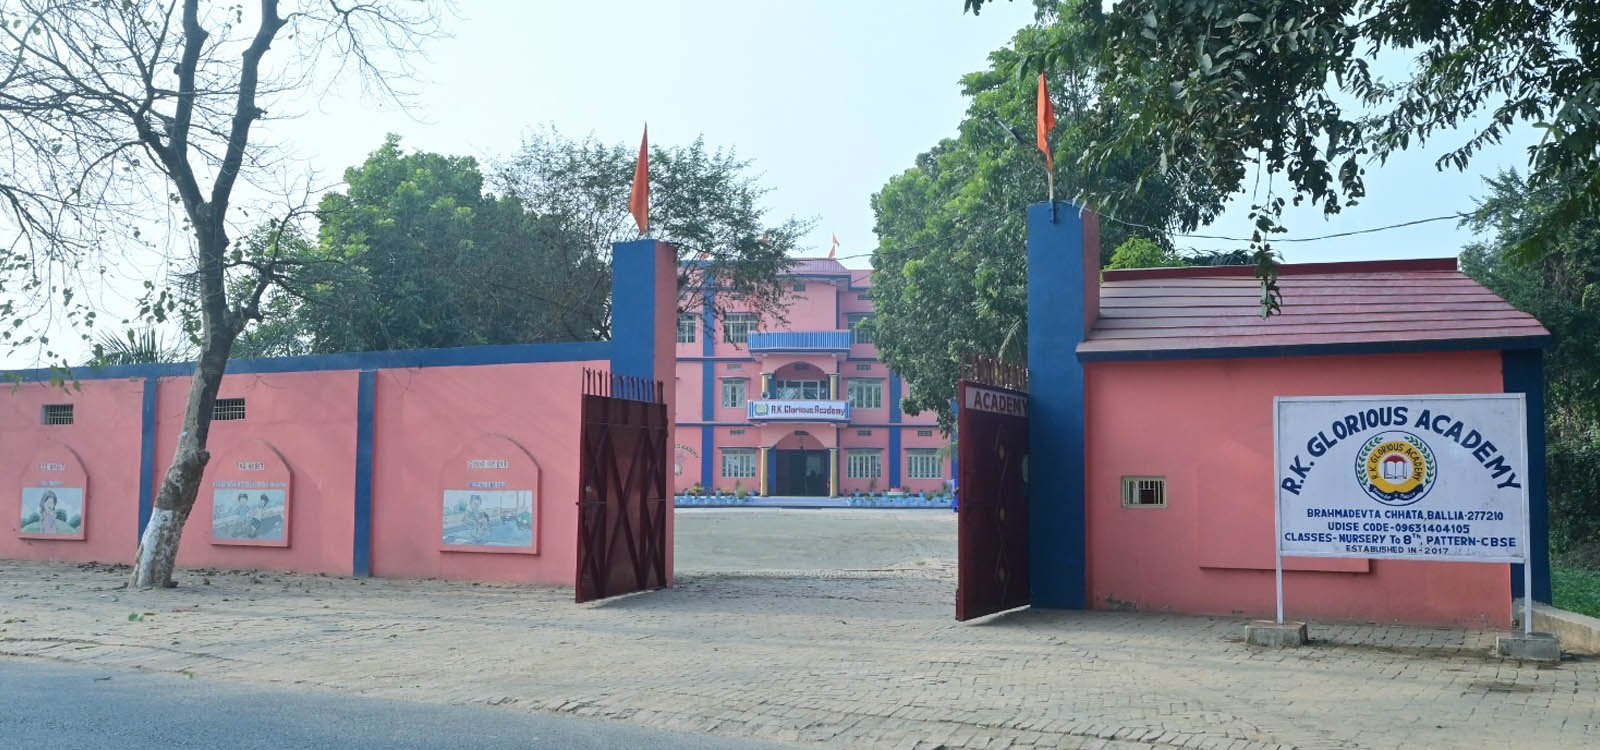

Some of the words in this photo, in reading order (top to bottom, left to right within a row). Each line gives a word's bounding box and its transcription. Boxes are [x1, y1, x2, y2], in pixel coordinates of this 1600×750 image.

[784, 405, 814, 414] Glorious
[815, 405, 845, 416] Academy
[1281, 455, 1315, 495] R.K.
[1307, 406, 1409, 458] GLORIOUS
[1414, 409, 1522, 491] ACADEMY
[1370, 443, 1405, 464] GLORIOUS
[1406, 447, 1423, 482] ACADEMY
[1307, 508, 1381, 519] BRAHMADEVTA
[1327, 521, 1359, 531] UDISE
[1390, 534, 1401, 545] To
[1345, 544, 1404, 554] ESTABLISHED
